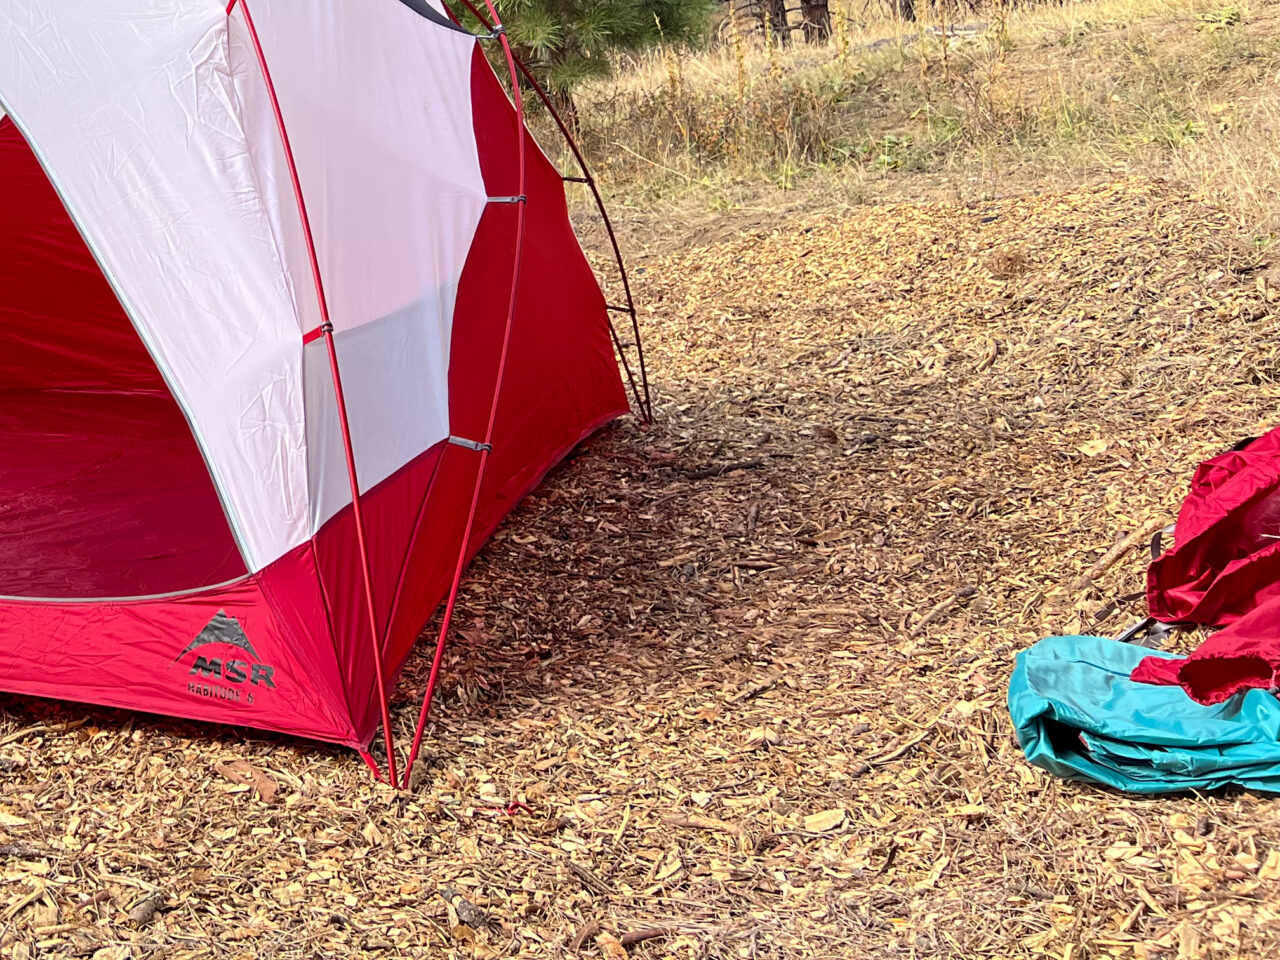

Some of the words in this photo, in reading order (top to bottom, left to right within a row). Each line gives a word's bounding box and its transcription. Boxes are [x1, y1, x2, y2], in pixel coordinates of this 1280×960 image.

[189, 655, 276, 688] MSR
[188, 682, 242, 702] HABITUDE
[247, 692, 254, 704] 6
